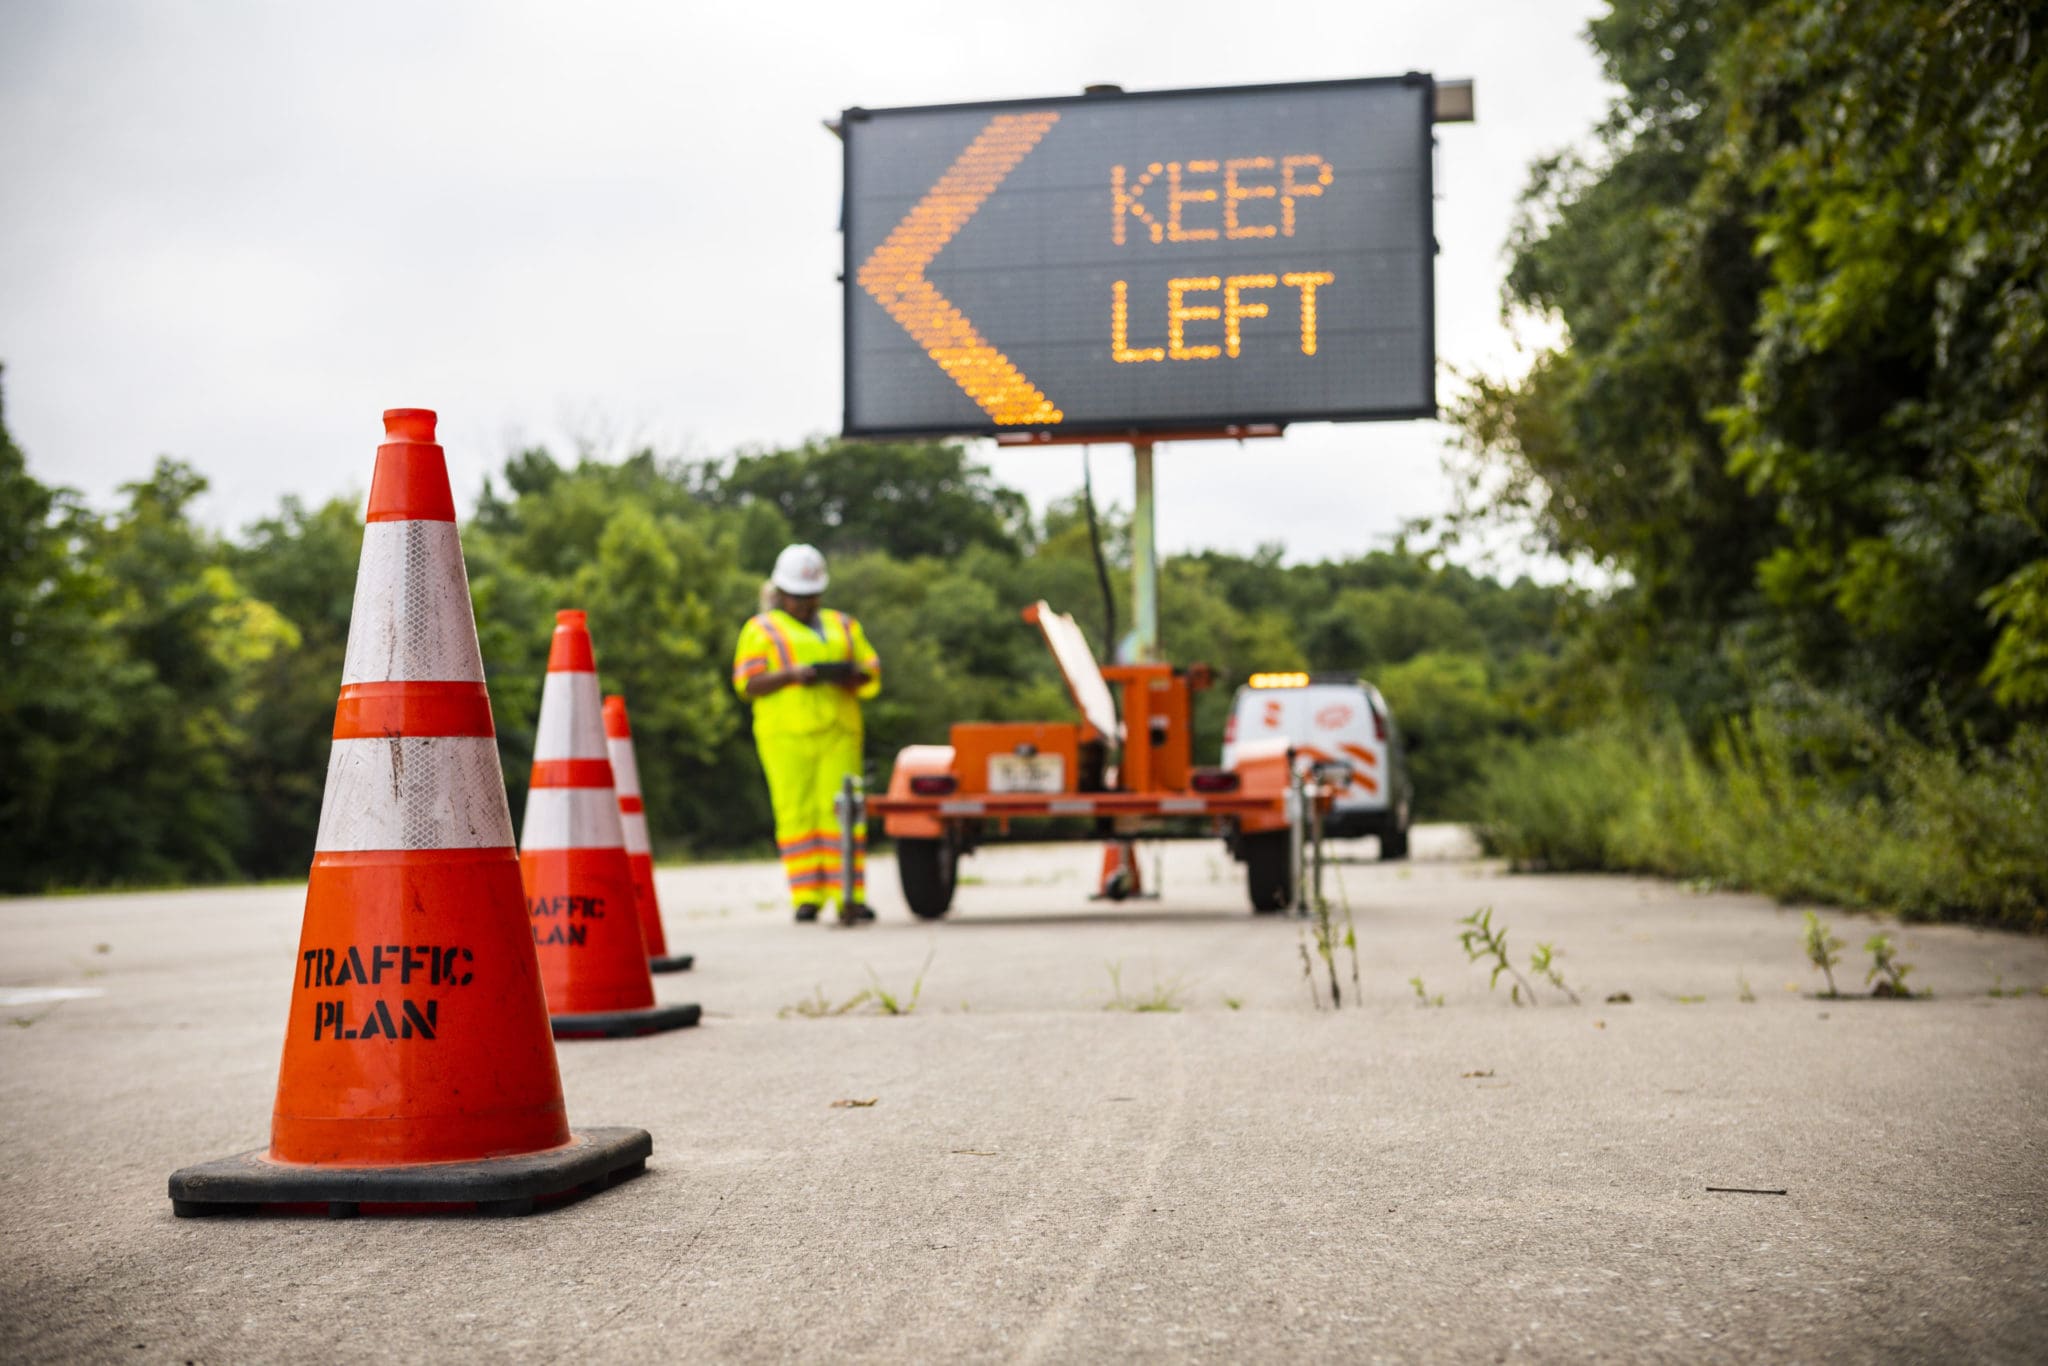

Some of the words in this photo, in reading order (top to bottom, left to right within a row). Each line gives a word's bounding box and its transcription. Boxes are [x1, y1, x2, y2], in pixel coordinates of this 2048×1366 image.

[1111, 153, 1334, 246] KEEP
[1112, 271, 1335, 363] LEFT
[527, 895, 605, 919] AFFIC
[532, 923, 587, 946] LAN
[303, 945, 474, 988] TRAFFIC
[314, 999, 438, 1041] PLAN
